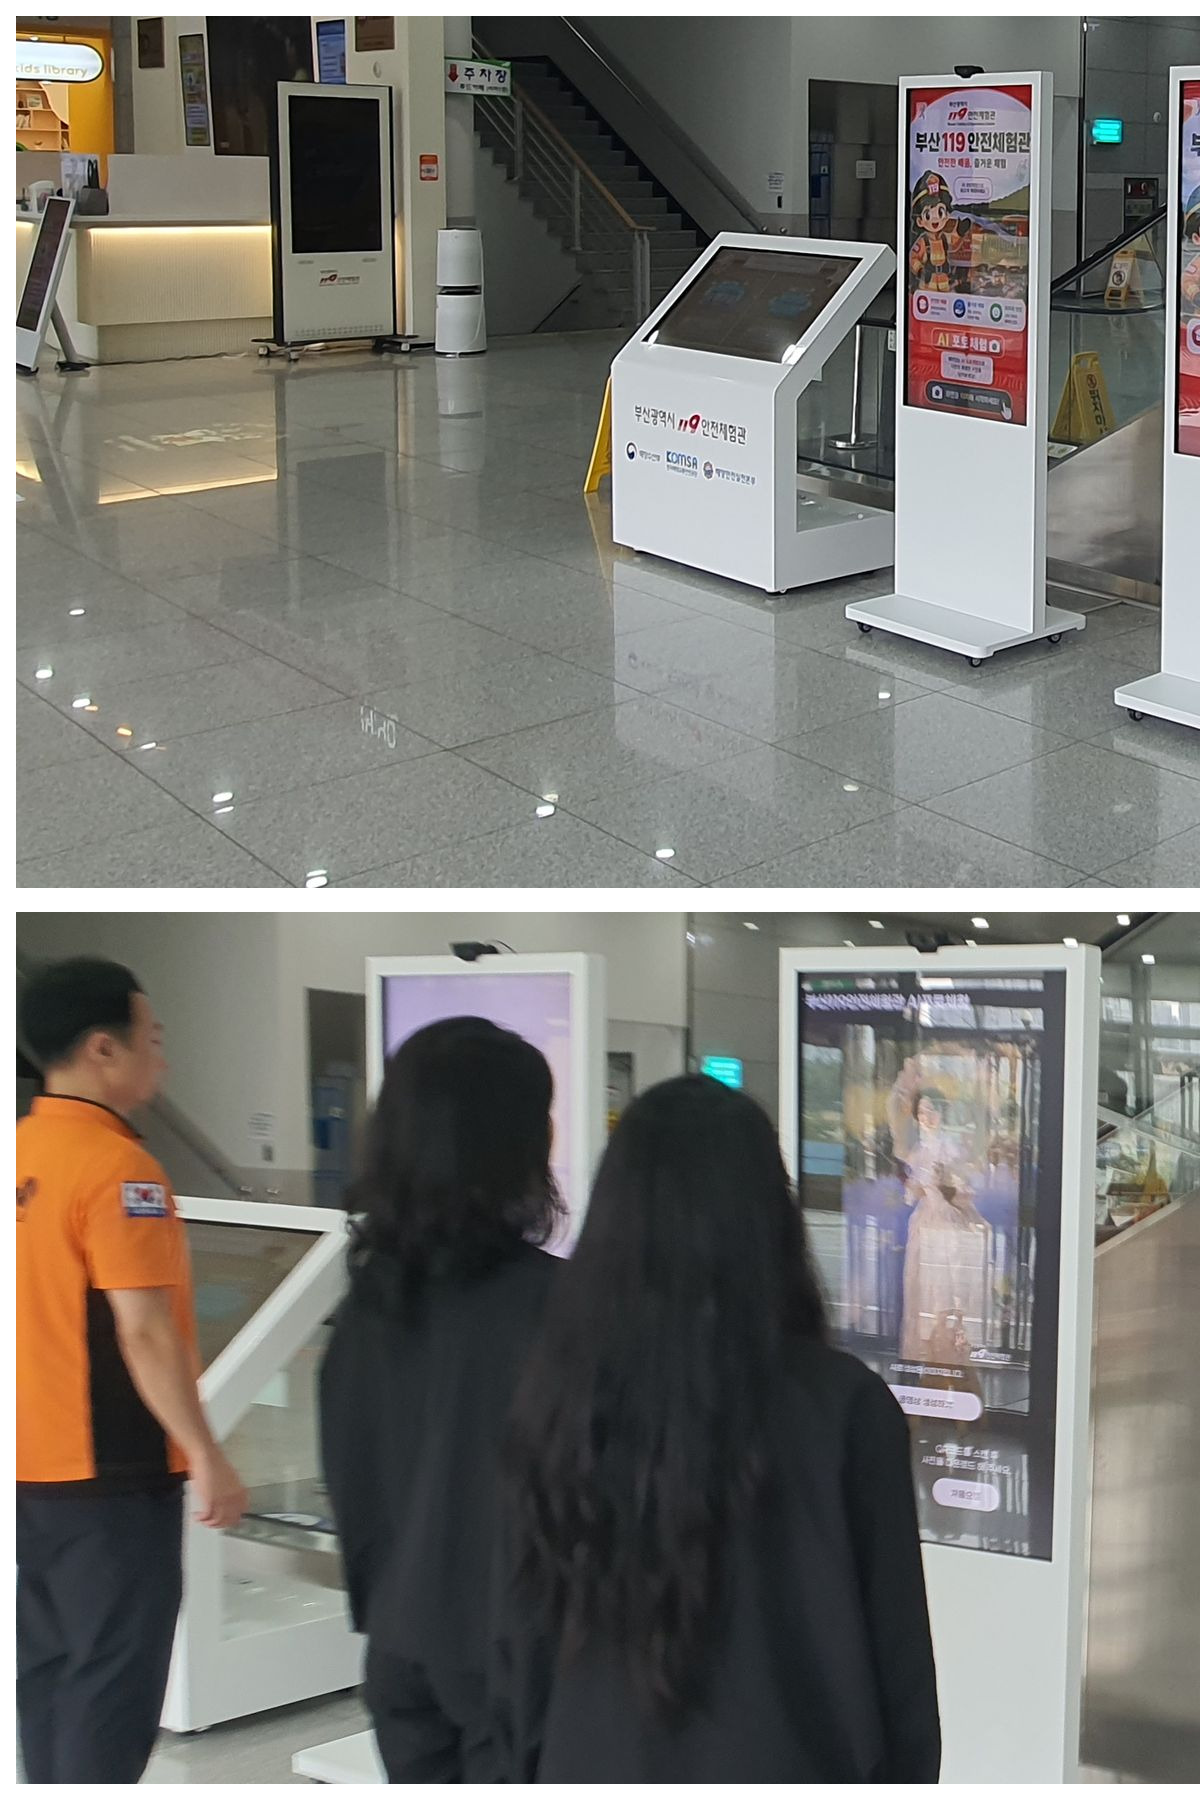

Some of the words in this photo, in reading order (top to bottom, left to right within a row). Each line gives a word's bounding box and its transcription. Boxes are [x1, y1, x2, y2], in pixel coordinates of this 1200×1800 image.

[44, 64, 88, 77] library
[968, 132, 1031, 153] 안전체험관
[938, 332, 949, 347] AI
[634, 404, 676, 430] 부산광역시
[677, 414, 700, 434] 119
[701, 419, 747, 445] 안전체험관
